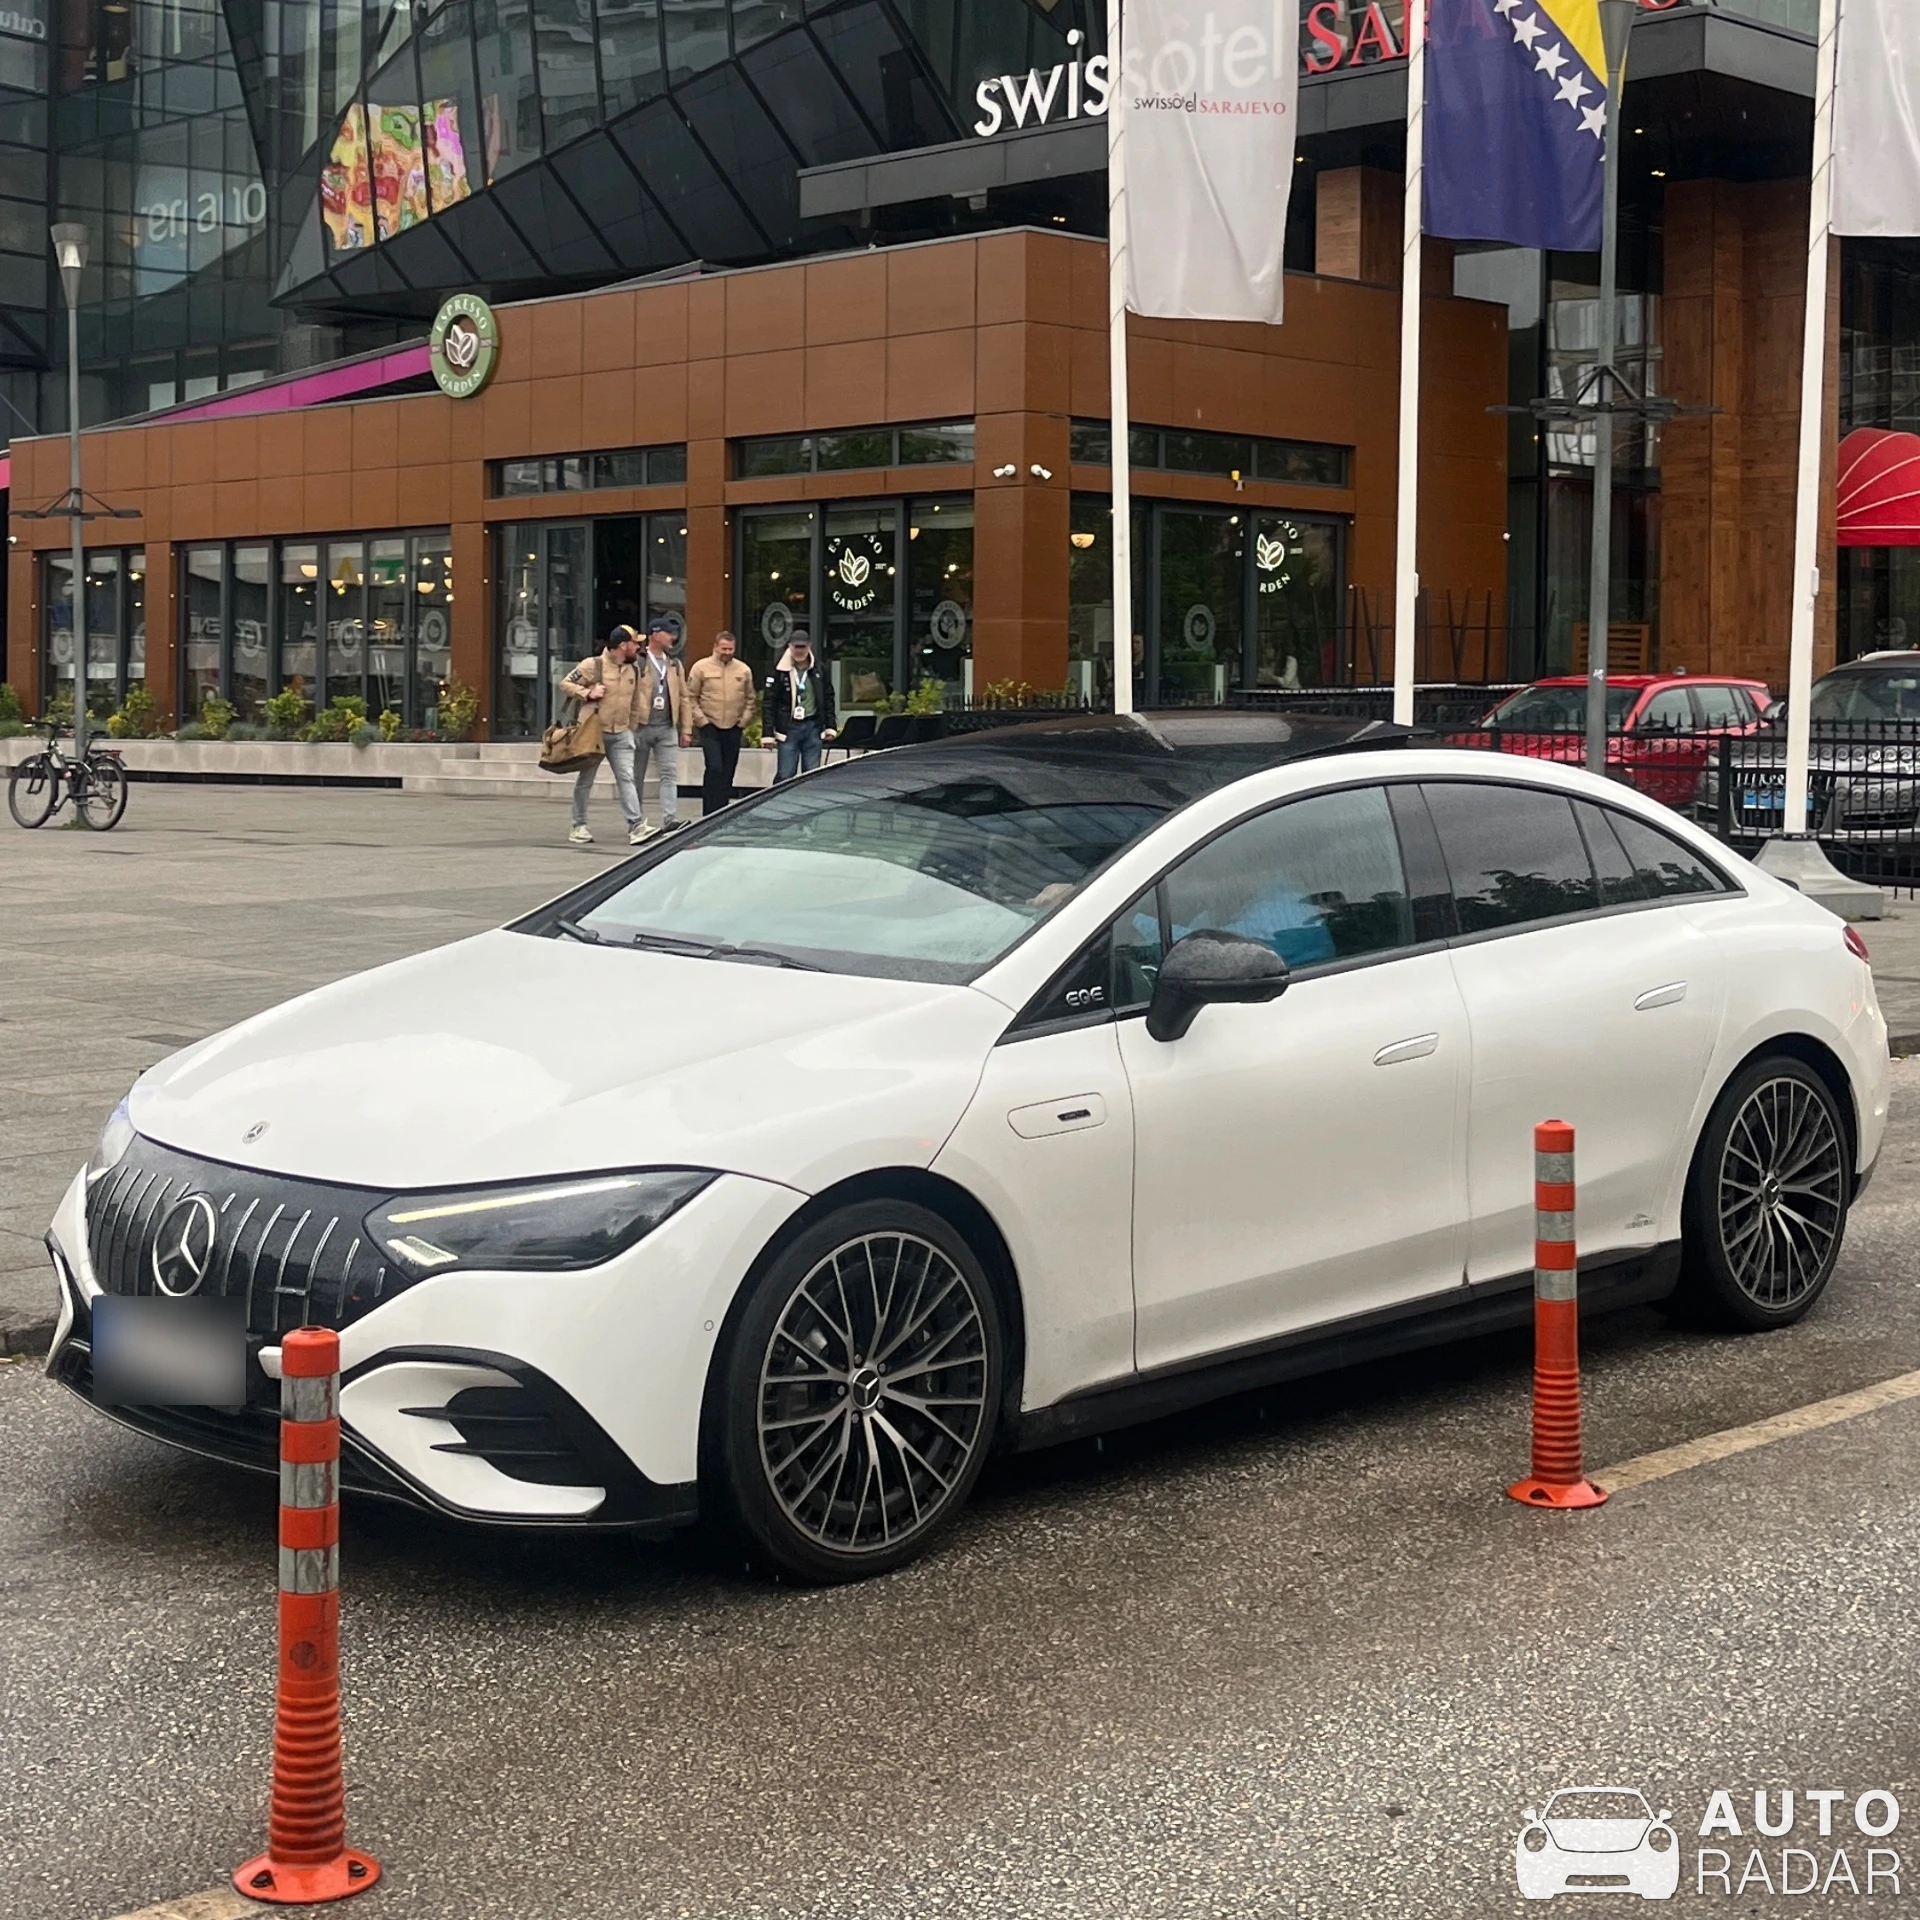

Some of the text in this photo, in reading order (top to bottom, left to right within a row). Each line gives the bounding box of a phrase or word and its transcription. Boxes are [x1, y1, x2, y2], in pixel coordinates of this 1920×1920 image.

[1199, 99, 1287, 115] SARAJEVO
[435, 298, 488, 333] ESPRESSO
[440, 369, 481, 393] GARDEN
[832, 589, 876, 611] GARDEN
